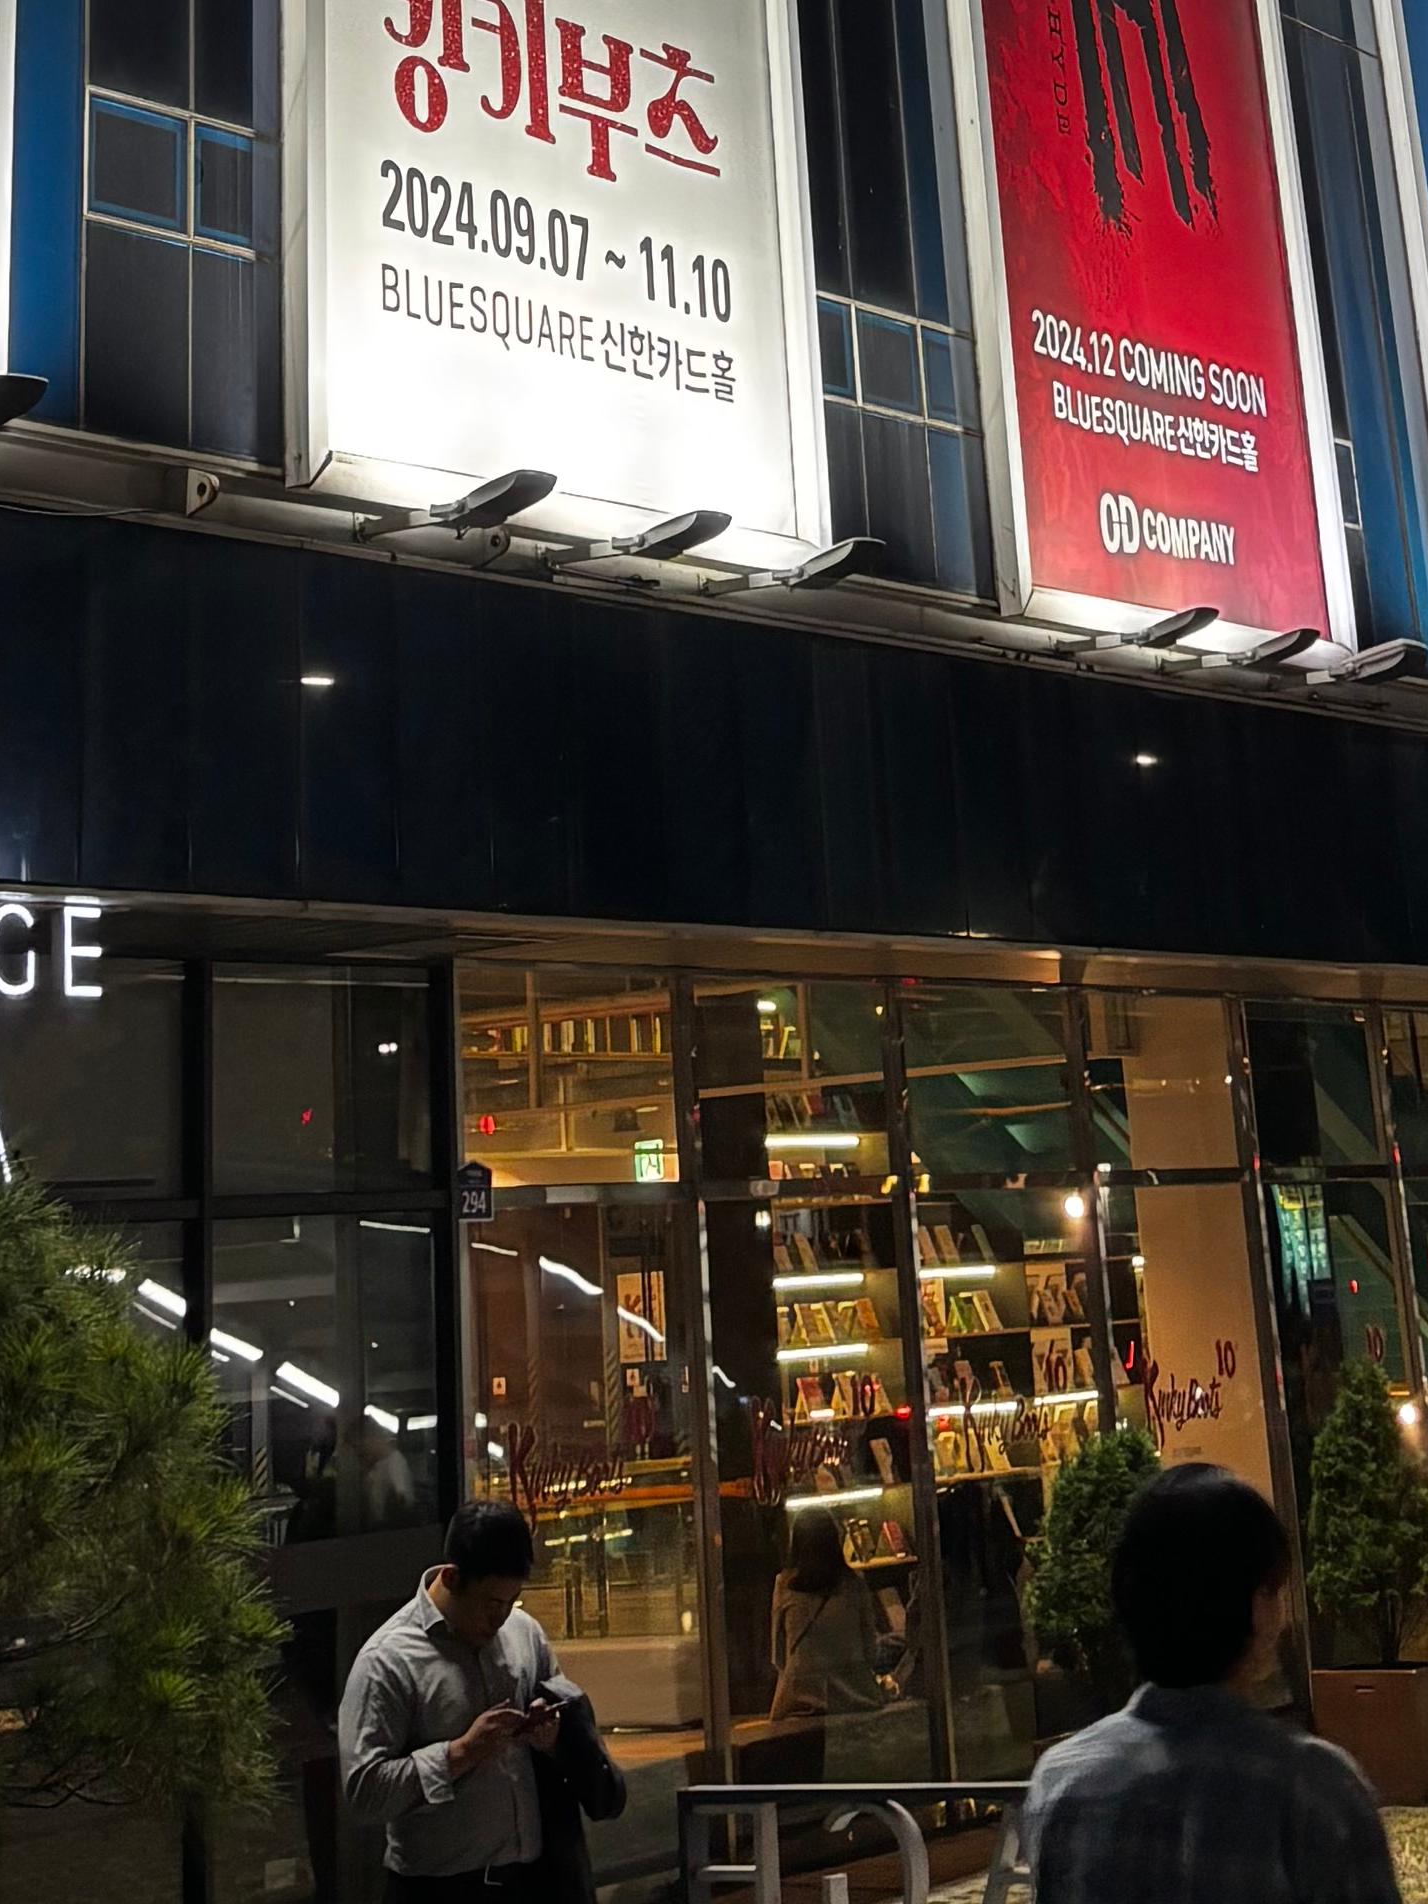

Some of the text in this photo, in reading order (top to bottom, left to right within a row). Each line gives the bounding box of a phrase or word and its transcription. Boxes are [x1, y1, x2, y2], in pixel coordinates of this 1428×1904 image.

[380, 159, 590, 282] 2024.09.07
[639, 236, 732, 324] 11.10
[1031, 309, 1268, 418] 2024.12 COMING SOON
[1143, 508, 1235, 566] COMPANY
[462, 1191, 486, 1214] 294
[1215, 1339, 1237, 1379] 10
